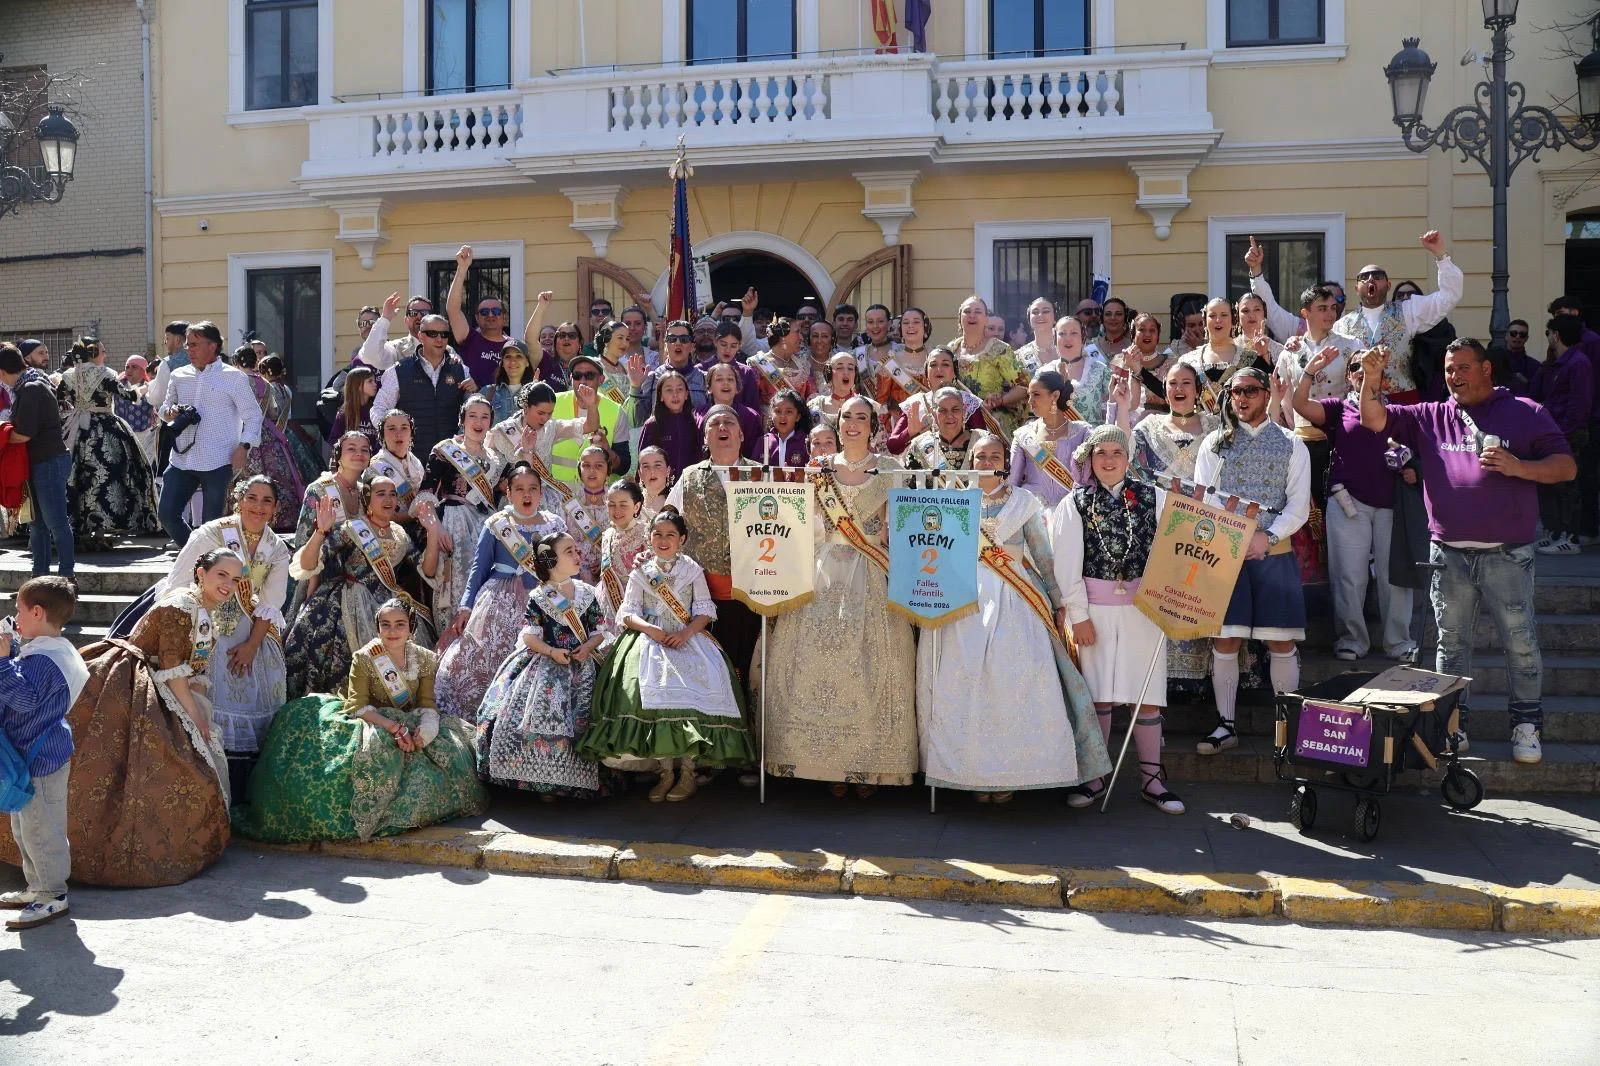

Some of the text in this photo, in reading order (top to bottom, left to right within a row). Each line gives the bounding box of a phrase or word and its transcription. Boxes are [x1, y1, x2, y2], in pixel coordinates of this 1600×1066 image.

[1441, 442, 1460, 451] SAN
[1173, 500, 1247, 530] JUNTA LOCAL FALLERA
[746, 523, 791, 538] PREMI
[758, 538, 776, 562] 2
[909, 533, 954, 550] PREMI
[920, 548, 938, 574] 2
[1175, 543, 1220, 568] PREMI
[1182, 562, 1199, 587] 1
[912, 589, 944, 597] Infantils
[1165, 586, 1201, 603] Cavalcada
[1145, 588, 1163, 600] Millor
[1194, 607, 1216, 619] Infantil
[1159, 605, 1198, 625] Godella 2026
[1319, 713, 1352, 726] FALLA
[1323, 729, 1346, 740] SAN
[1302, 740, 1363, 758] SEBASTIÁN
